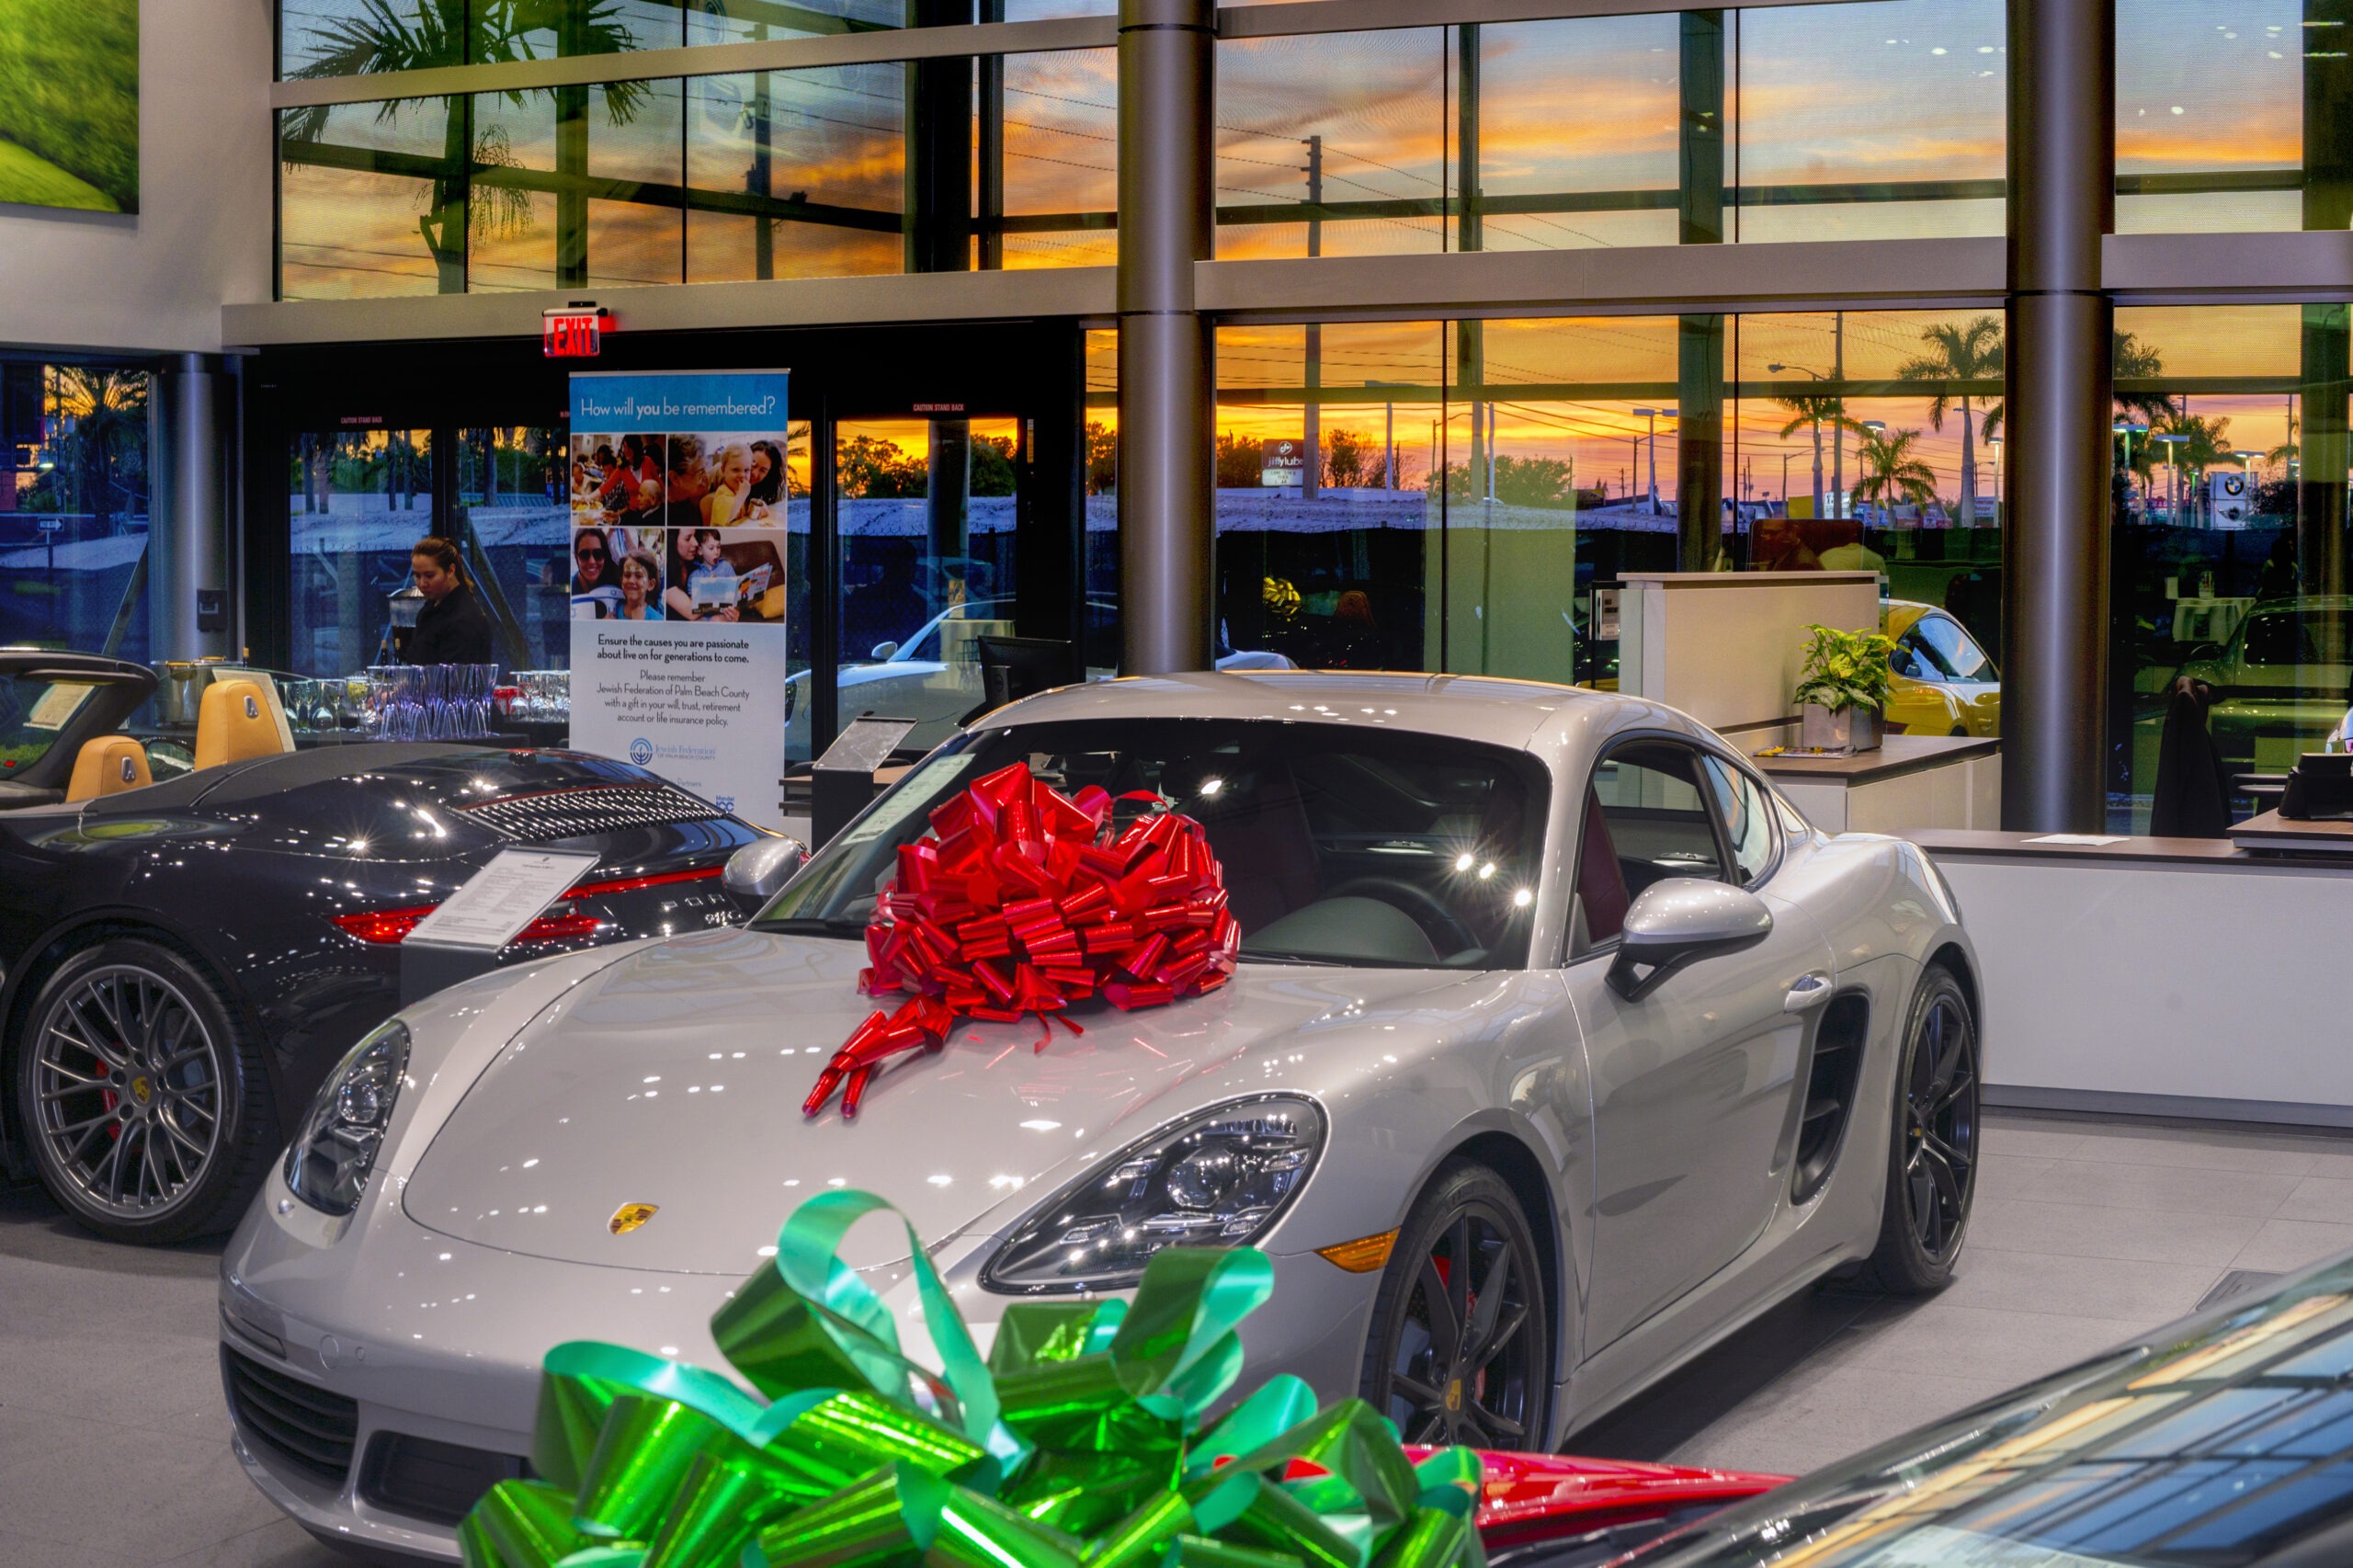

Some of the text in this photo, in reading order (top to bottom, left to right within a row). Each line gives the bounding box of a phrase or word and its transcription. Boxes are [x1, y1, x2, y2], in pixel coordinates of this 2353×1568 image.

[553, 317, 593, 355] EXIT
[581, 395, 776, 421] How will you be remembered?
[913, 403, 933, 412] CAUTION
[597, 633, 749, 651] Ensure the causes you are passionate
[597, 647, 621, 659] about
[623, 648, 636, 659] live
[650, 648, 663, 661] for
[664, 652, 713, 664] generations
[714, 653, 722, 663] to
[724, 654, 750, 664] come.
[640, 669, 706, 683] Please remember
[597, 682, 750, 700] Jewish Federation of Palm Beach County
[604, 697, 620, 707] with
[628, 698, 640, 710] gift
[640, 698, 647, 709] in
[648, 701, 665, 711] your
[667, 699, 681, 710] will,
[681, 700, 700, 711] trust,
[702, 702, 741, 712] retirement
[617, 712, 729, 728] account or life insurance policy.
[655, 744, 716, 755] Jewish Federation
[676, 778, 701, 788] Partners
